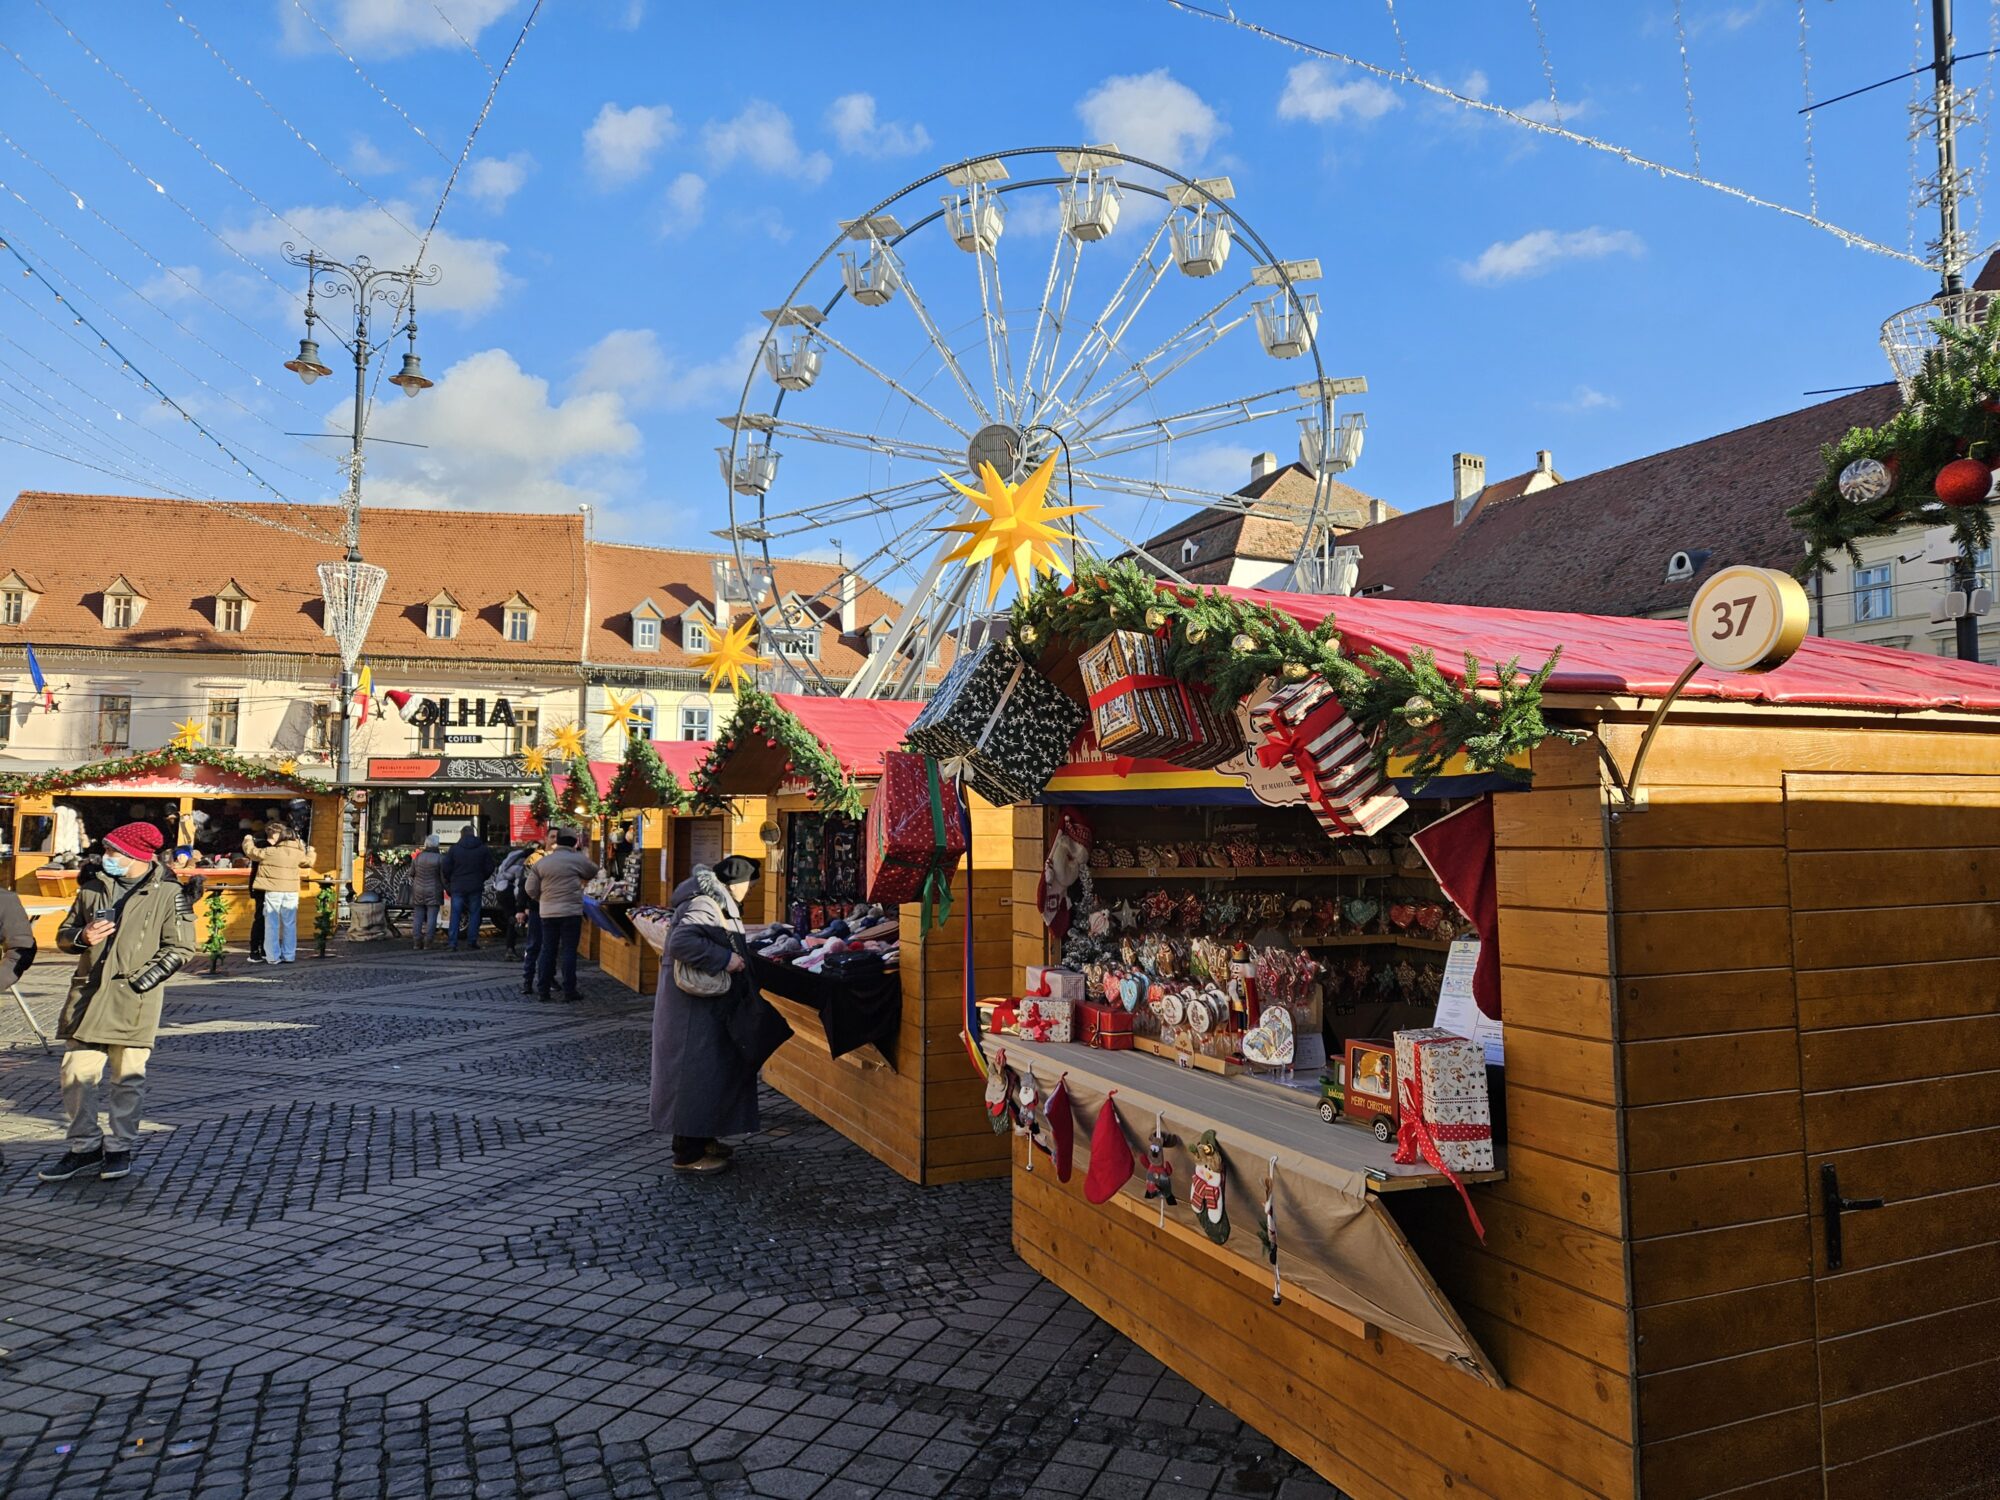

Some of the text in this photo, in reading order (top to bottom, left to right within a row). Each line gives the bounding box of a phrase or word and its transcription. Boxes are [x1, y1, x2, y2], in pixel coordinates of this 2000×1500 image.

[1711, 595, 1757, 640] 37
[447, 735, 477, 743] COFFEE
[1268, 782, 1284, 790] MAMA
[1328, 1088, 1345, 1100] Welcom
[1351, 1095, 1392, 1115] MERRY CHRISTMAS
